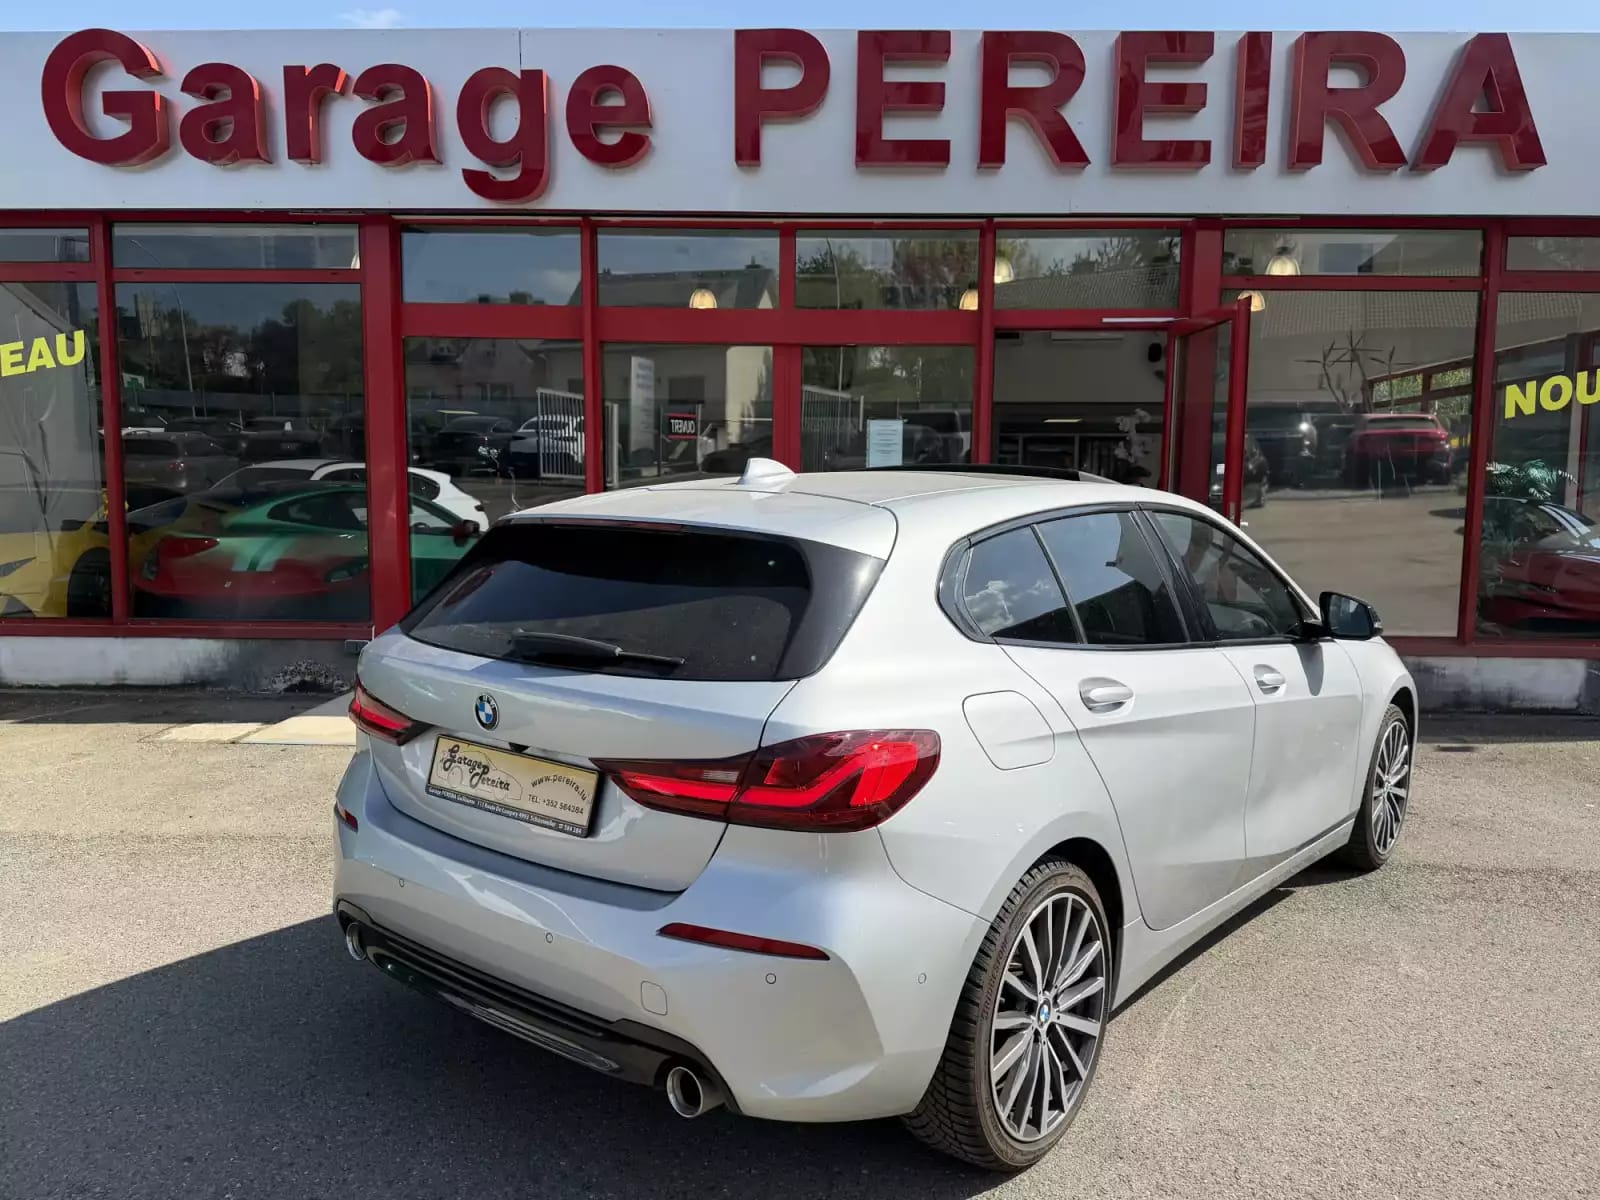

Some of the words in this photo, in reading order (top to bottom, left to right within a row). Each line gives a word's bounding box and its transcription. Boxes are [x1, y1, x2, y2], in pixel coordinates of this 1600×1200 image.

[41, 28, 652, 203] Garage
[734, 29, 1547, 172] PEREIRA
[0, 329, 86, 377] EAU
[1504, 367, 1600, 420] NOU
[443, 744, 484, 774] Garage
[469, 765, 512, 792] Pereira
[531, 774, 588, 802] www.pereira.lu
[528, 793, 541, 805] TEL:
[543, 798, 559, 809] +352
